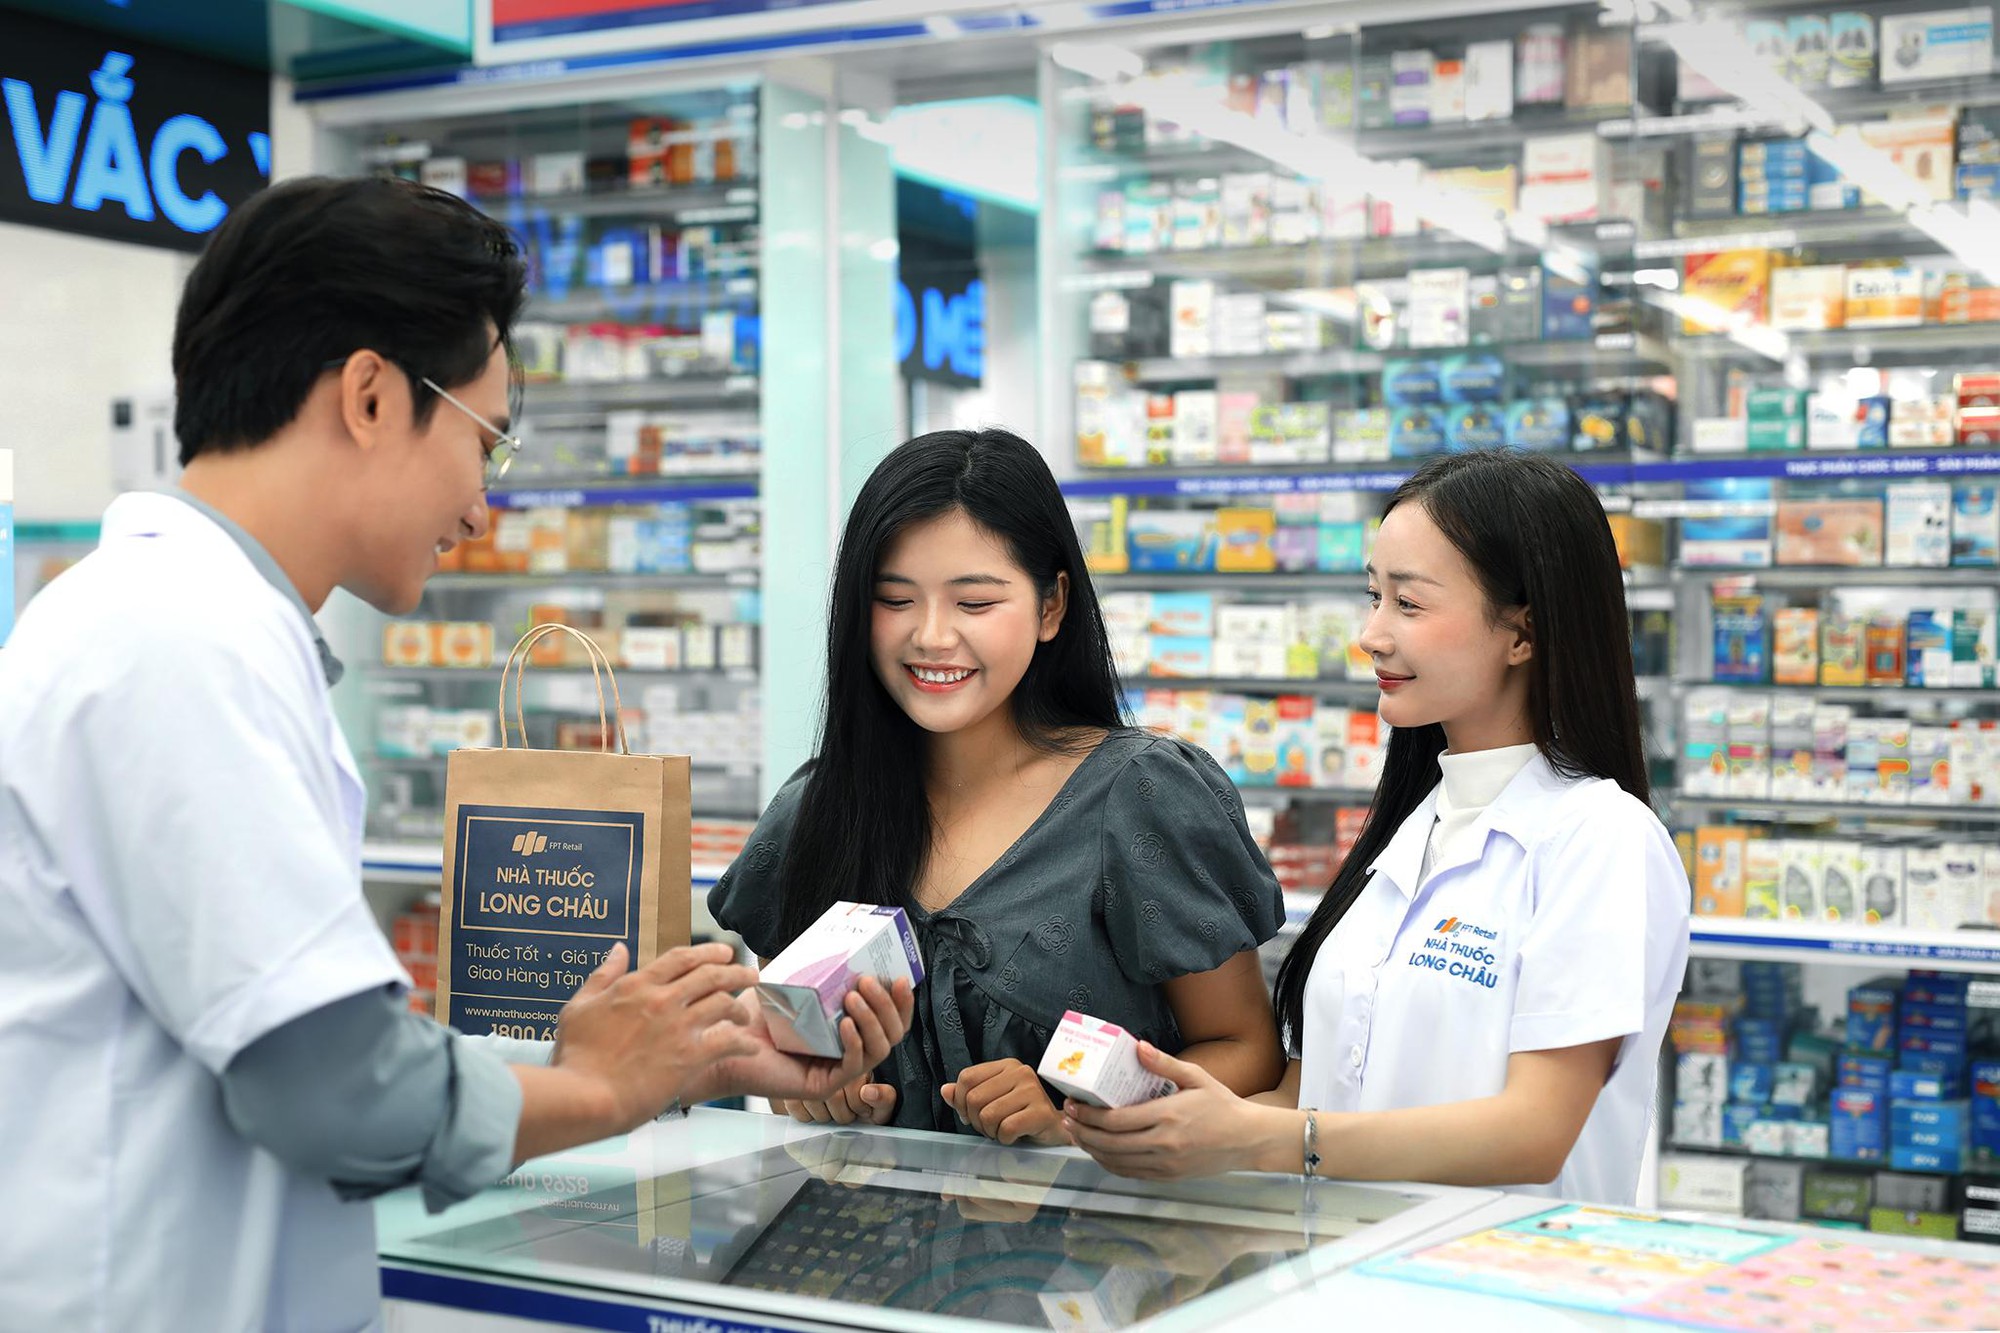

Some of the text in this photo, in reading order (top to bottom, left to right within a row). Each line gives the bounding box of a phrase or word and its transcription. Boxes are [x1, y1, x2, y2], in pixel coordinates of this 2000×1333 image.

[1, 50, 229, 234] VẮC
[549, 841, 583, 851] FPT Retail
[496, 864, 594, 888] NHÀ THUỐC
[480, 891, 608, 920] LONG CHÂU
[1460, 923, 1498, 940] FPT Retail
[466, 942, 613, 966] Thuốc Tốt Giá Tố
[1424, 937, 1495, 965] NHÀ THUỐC
[467, 965, 584, 990] Giao Hàng Tận
[1408, 952, 1498, 988] LONG CHÂU
[465, 1007, 559, 1025] www.nhathuoclong
